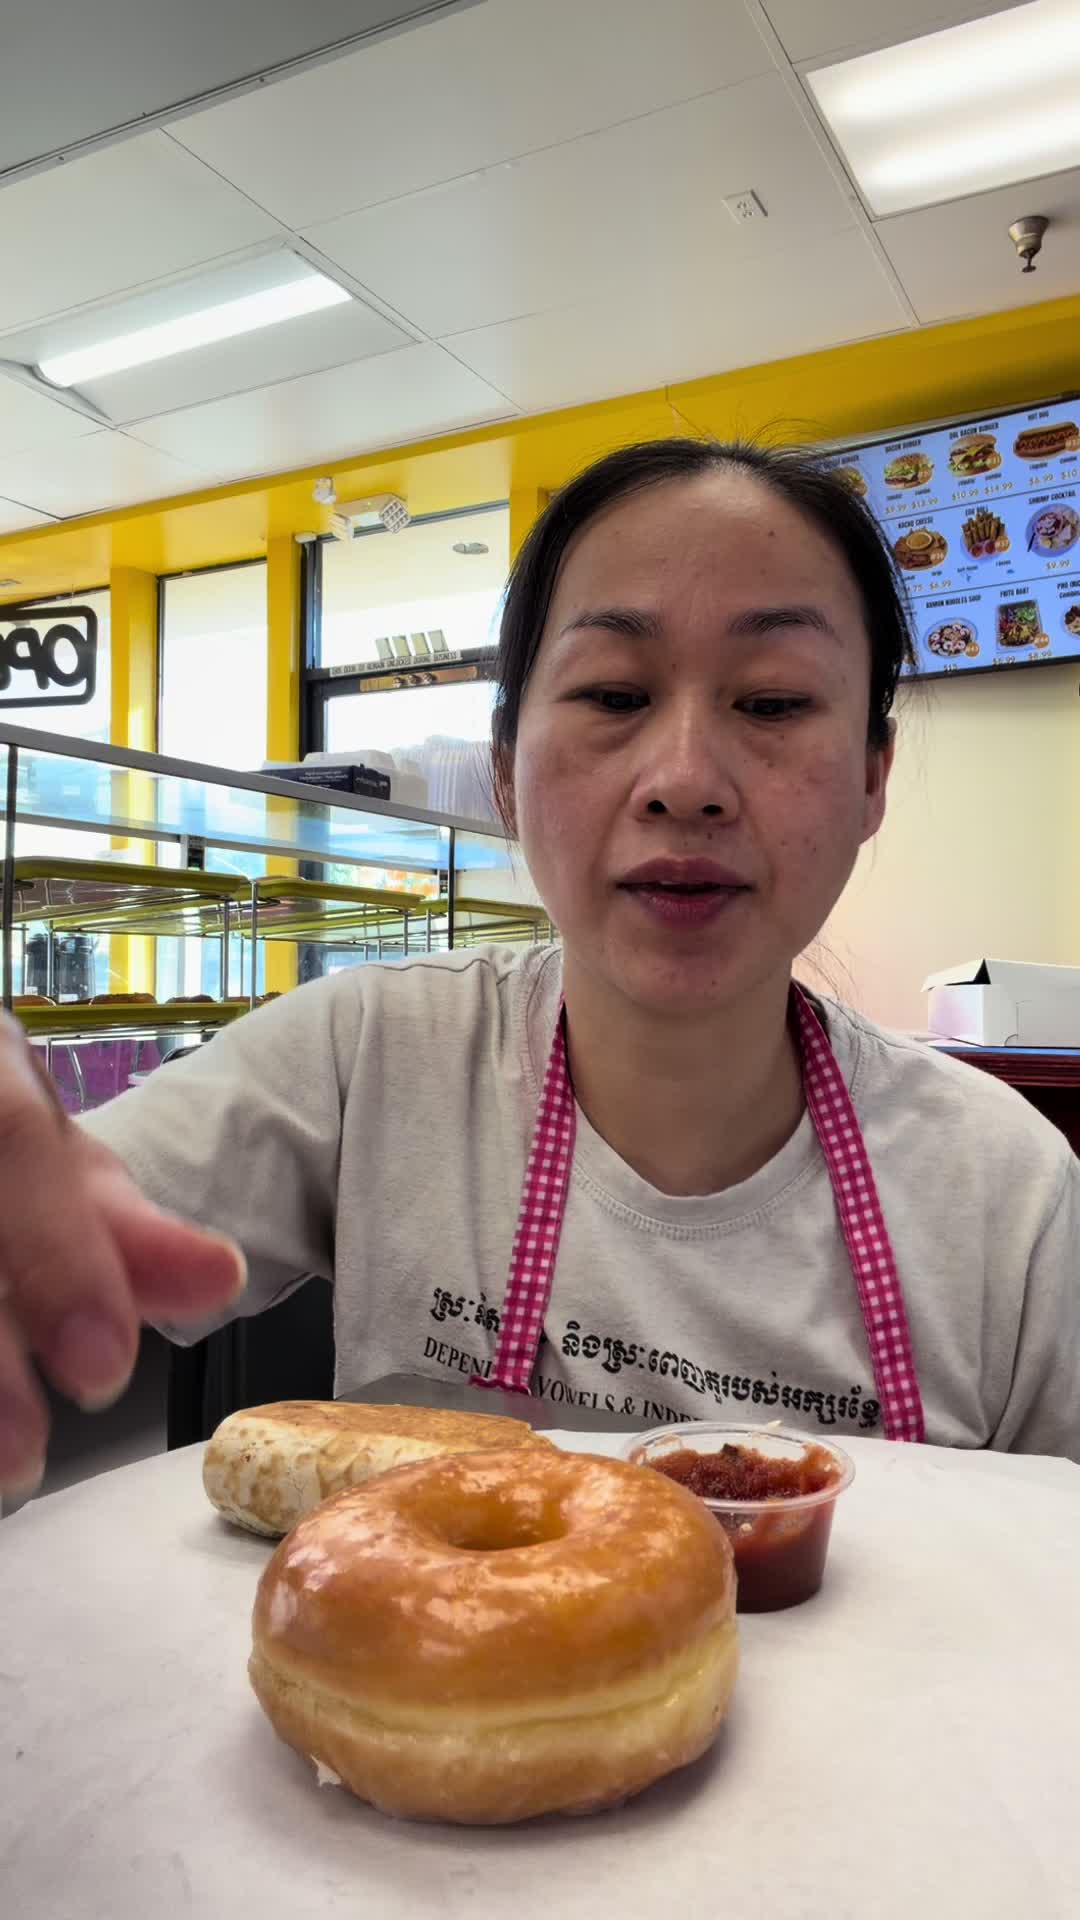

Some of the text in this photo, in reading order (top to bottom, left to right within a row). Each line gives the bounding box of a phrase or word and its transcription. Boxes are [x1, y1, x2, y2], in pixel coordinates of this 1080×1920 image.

[424, 1336, 493, 1379] DEPEN
[621, 1396, 636, 1415] &
[644, 1400, 704, 1423] INDE
